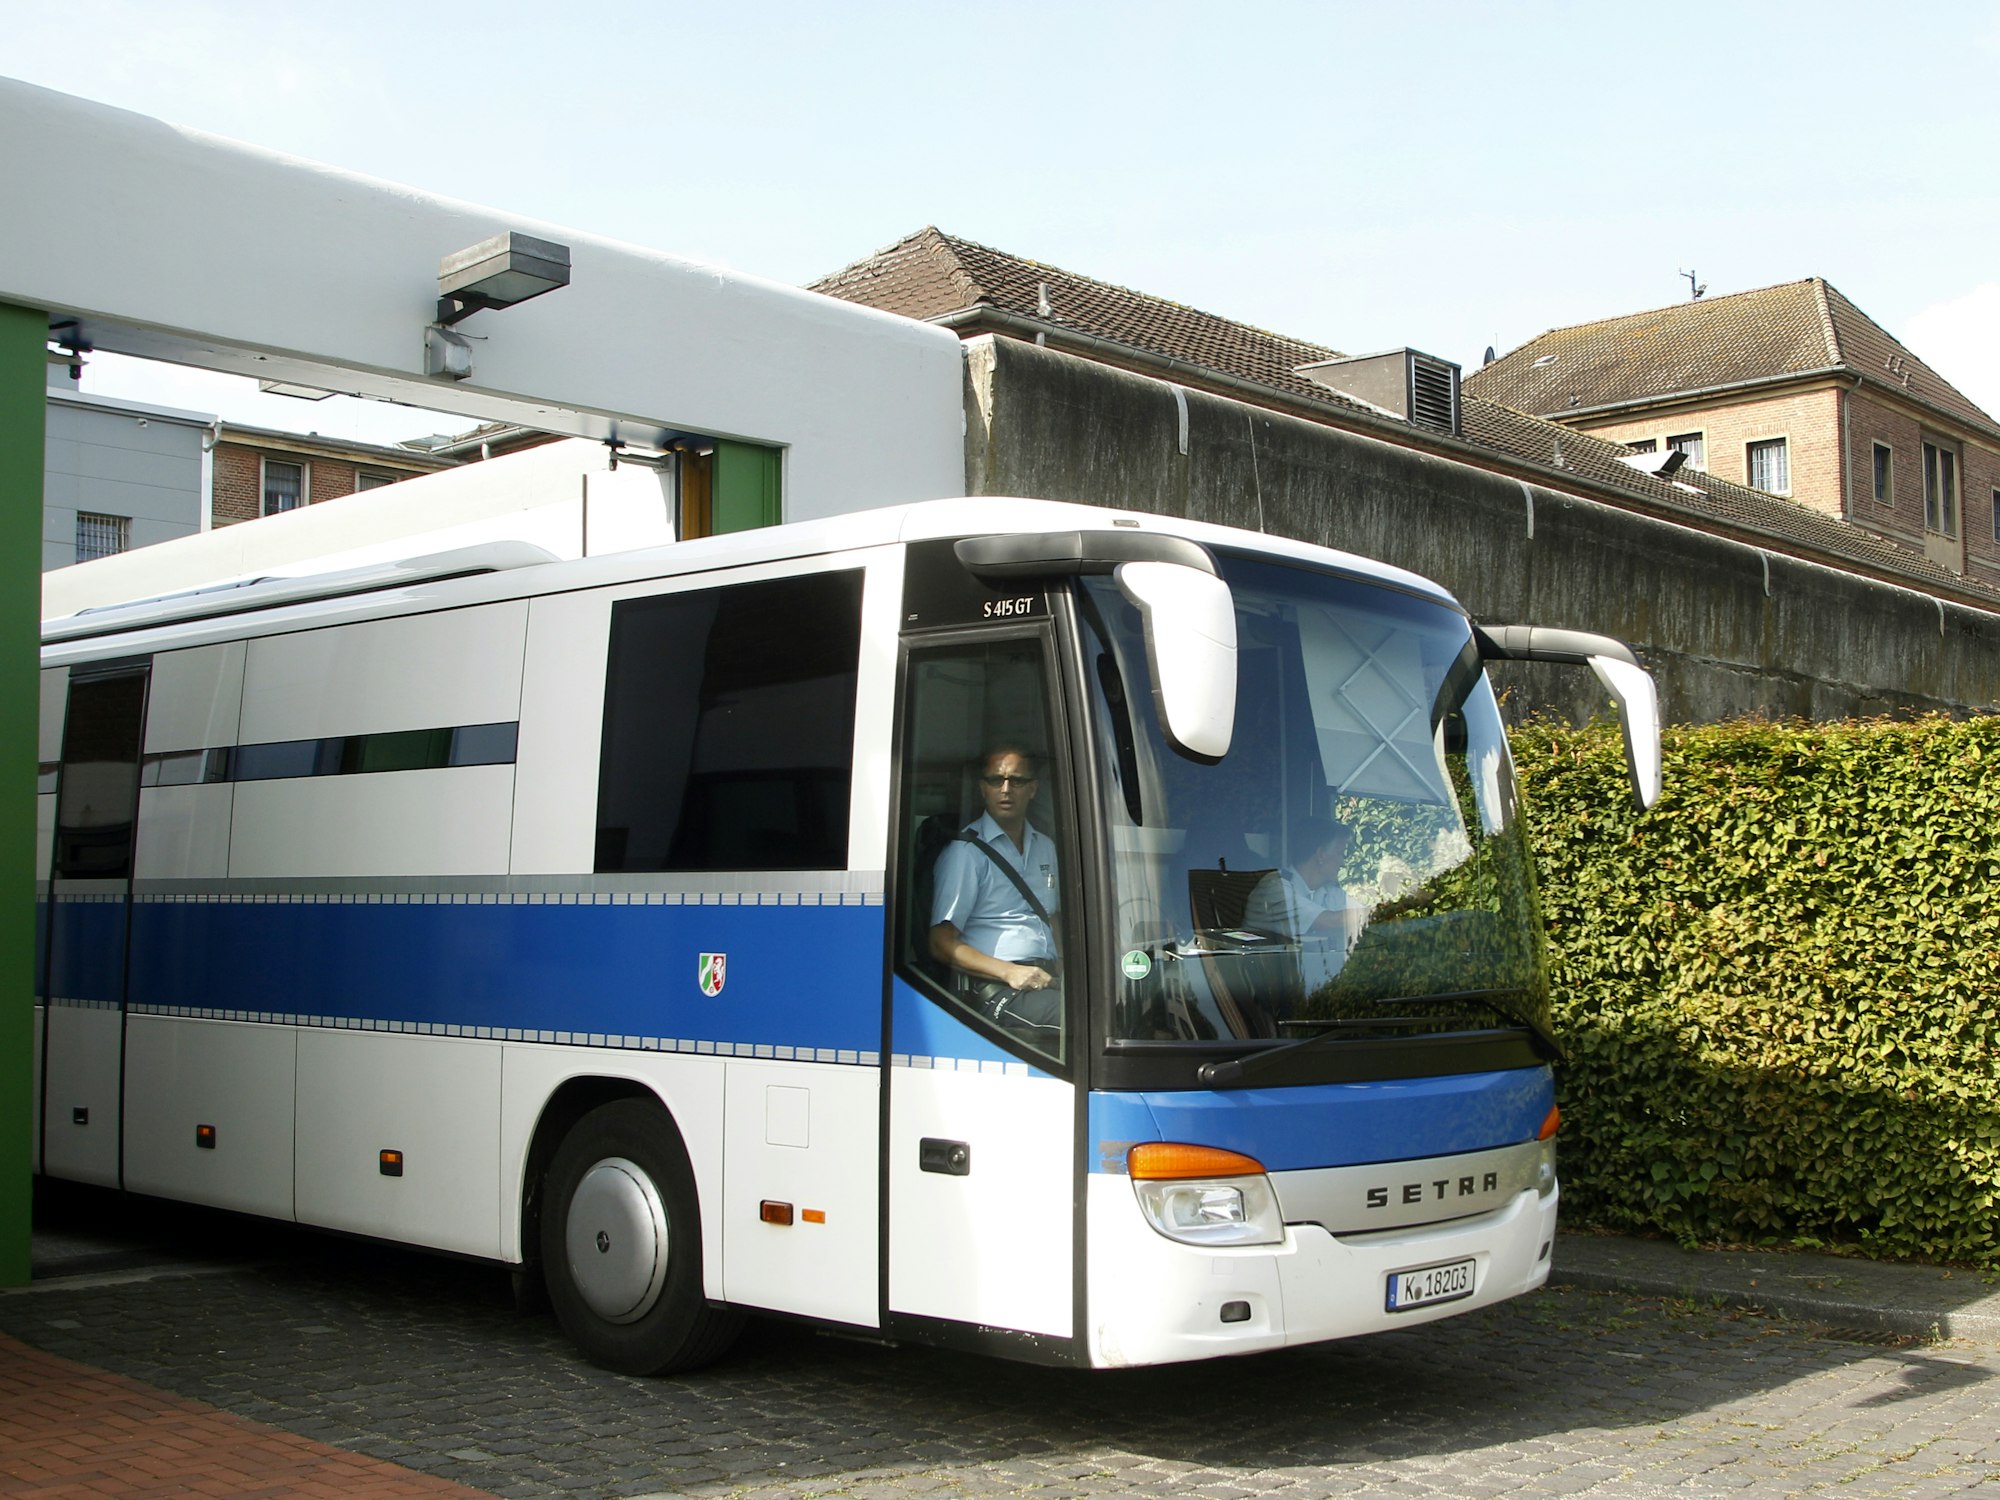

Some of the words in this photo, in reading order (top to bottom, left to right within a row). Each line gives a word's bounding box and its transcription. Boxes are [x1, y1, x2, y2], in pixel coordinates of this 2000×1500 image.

[1132, 952, 1140, 965] 4
[1367, 1172, 1497, 1208] SETRA
[1405, 1276, 1415, 1301] K
[1425, 1266, 1467, 1297] 18203
